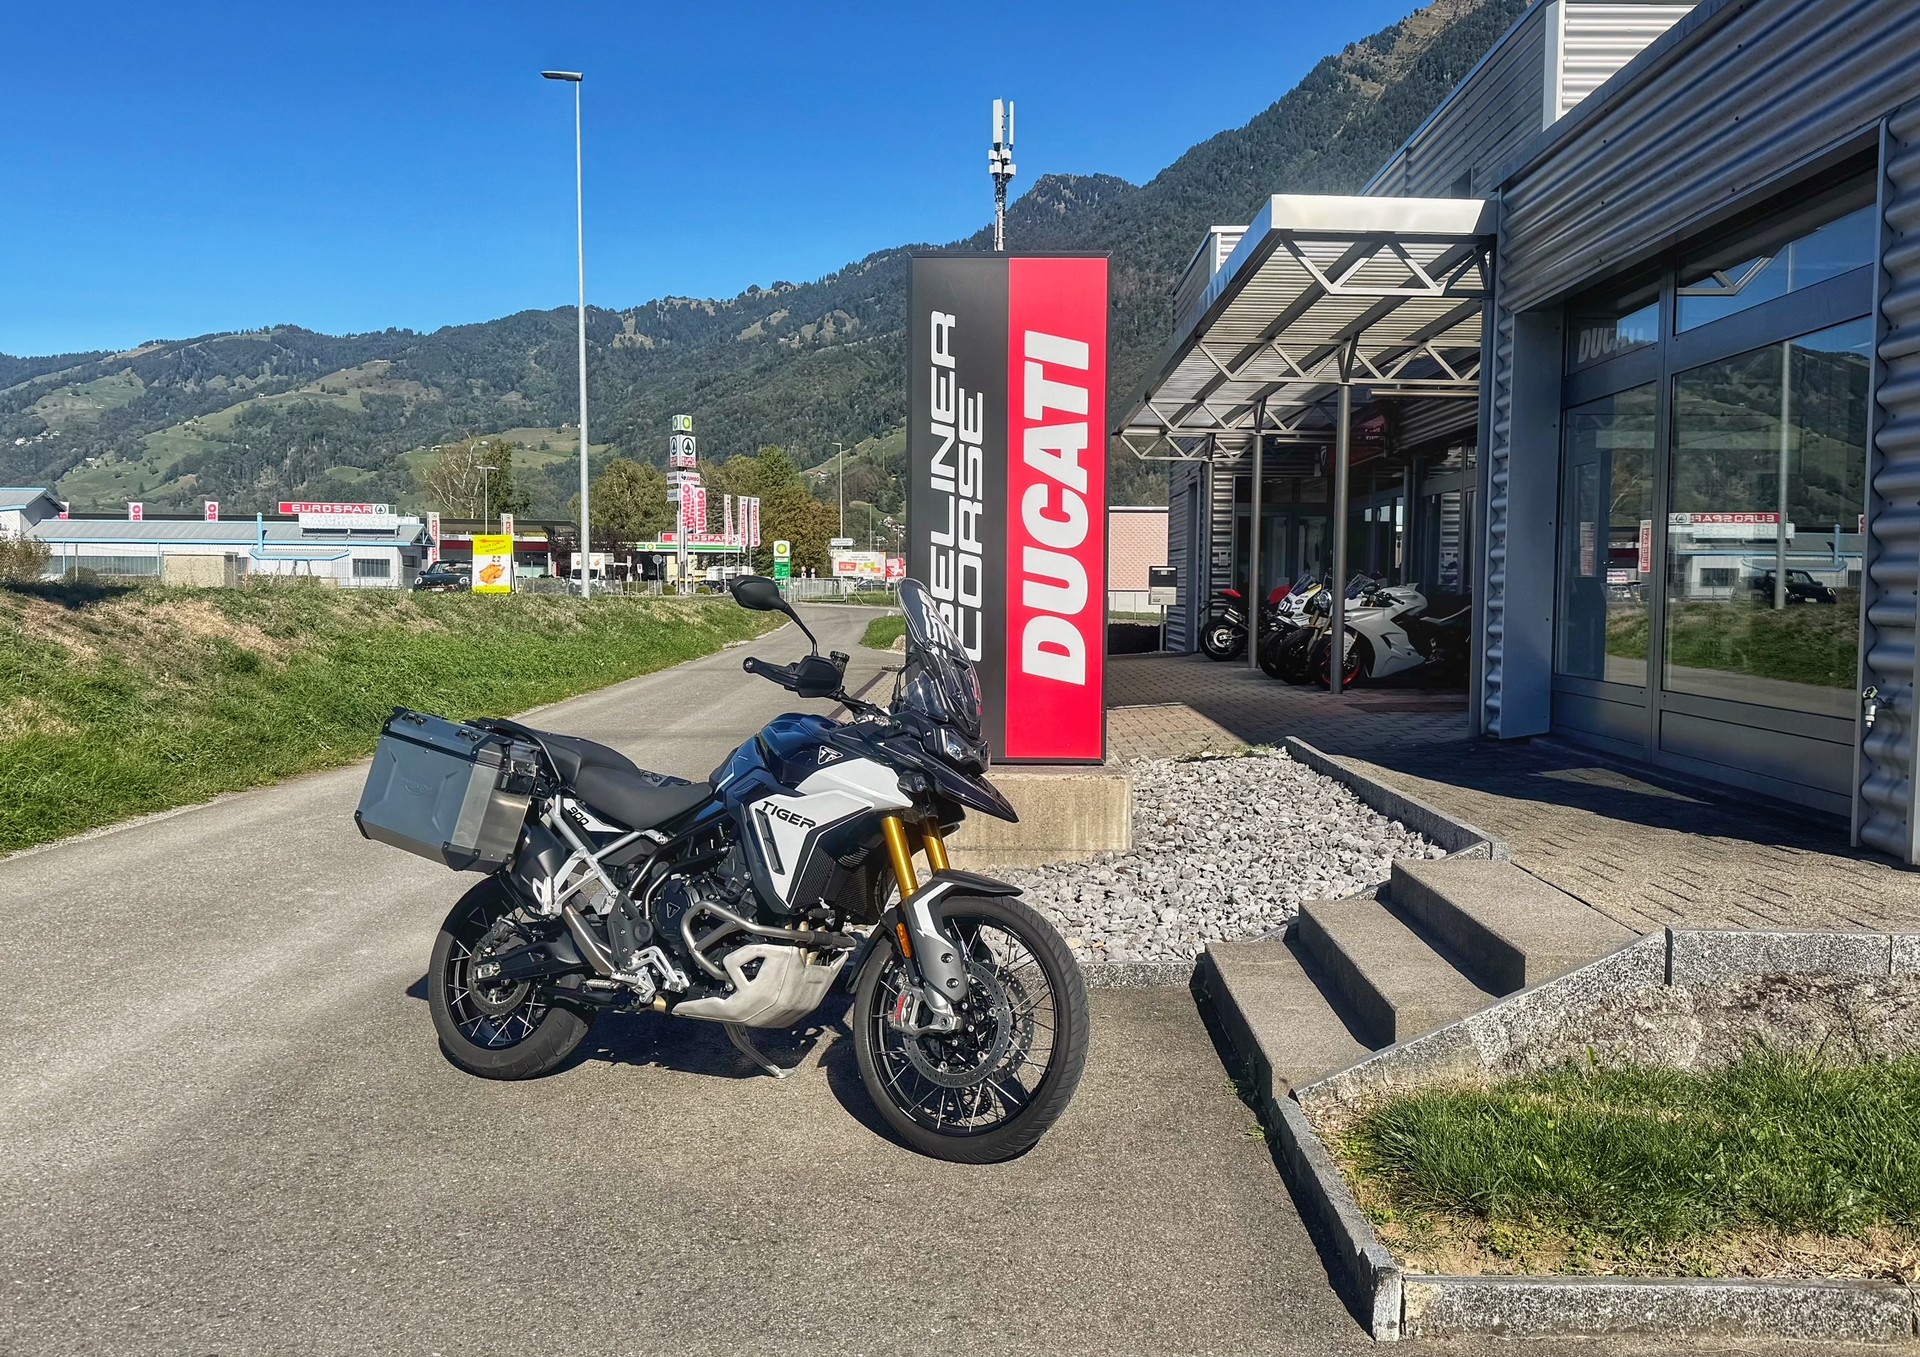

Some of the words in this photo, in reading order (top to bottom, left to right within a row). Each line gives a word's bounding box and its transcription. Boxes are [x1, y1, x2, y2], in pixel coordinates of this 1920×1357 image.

[291, 504, 373, 513] EUROSPAR
[697, 490, 705, 530] JUMBO
[957, 387, 983, 662] CORSE
[1021, 329, 1090, 686] DUCATI
[570, 806, 590, 826] 900
[762, 801, 817, 829] TIGER
